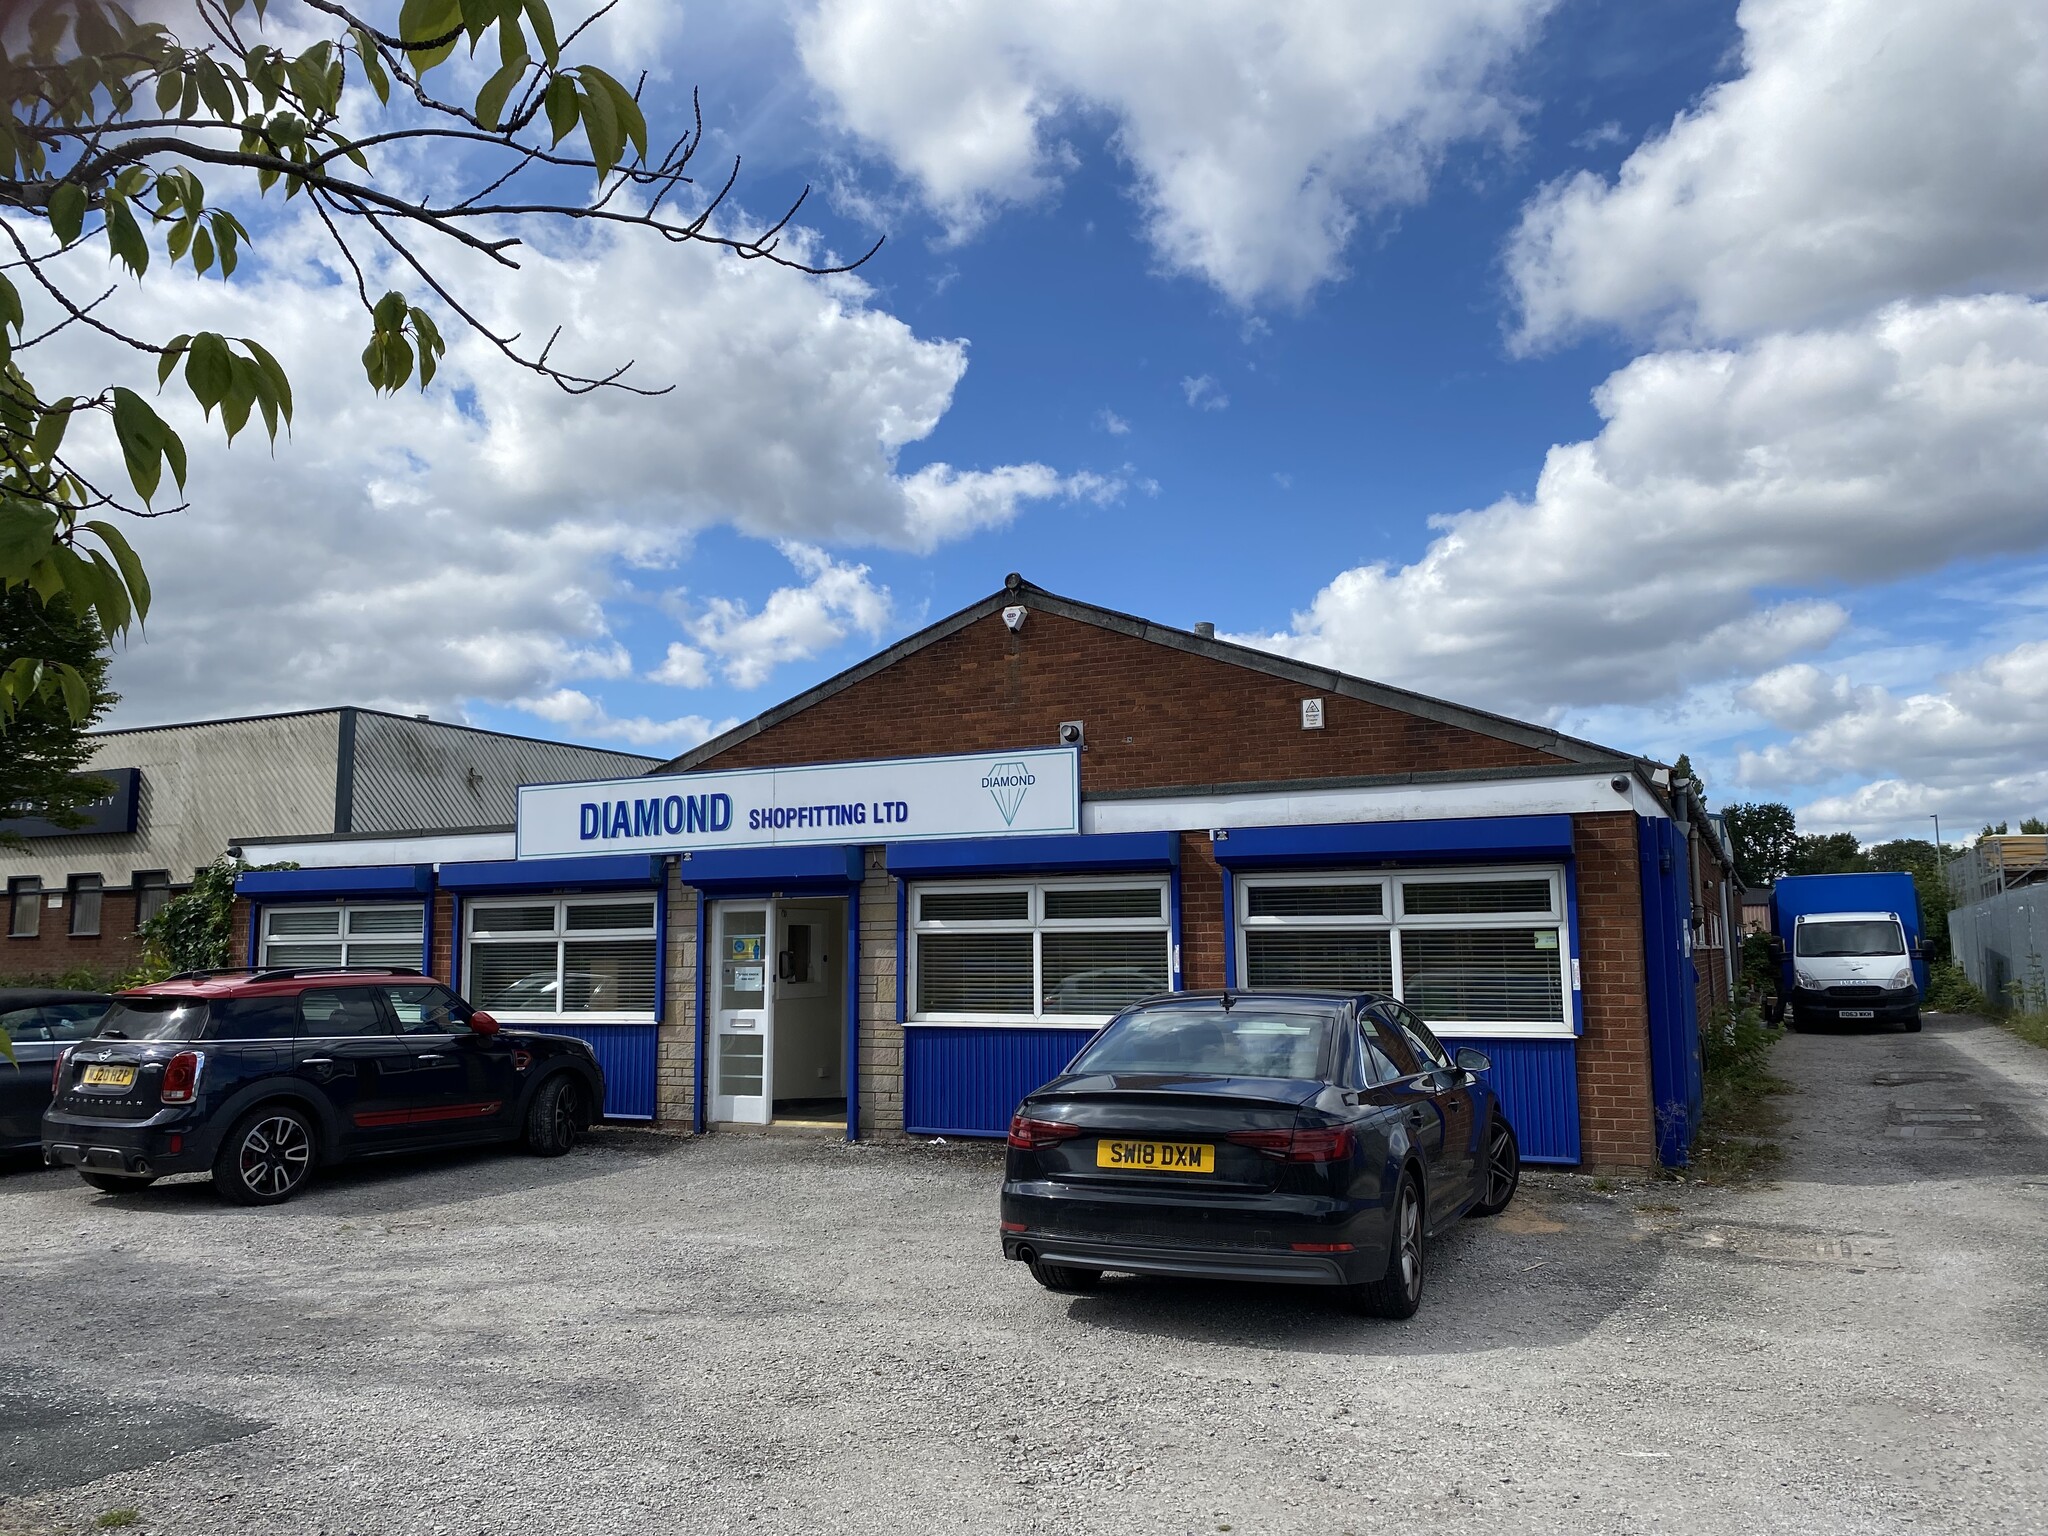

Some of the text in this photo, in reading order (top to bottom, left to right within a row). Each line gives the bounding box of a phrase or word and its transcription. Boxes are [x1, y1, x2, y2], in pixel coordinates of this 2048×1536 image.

[982, 774, 1036, 788] DIAMOND
[580, 793, 908, 840] DIAMOND SHOPFITTING LTD
[110, 1068, 130, 1082] HZP
[63, 1097, 143, 1105] COUNTRYMAN
[1110, 1143, 1202, 1167] SW18 DXM
